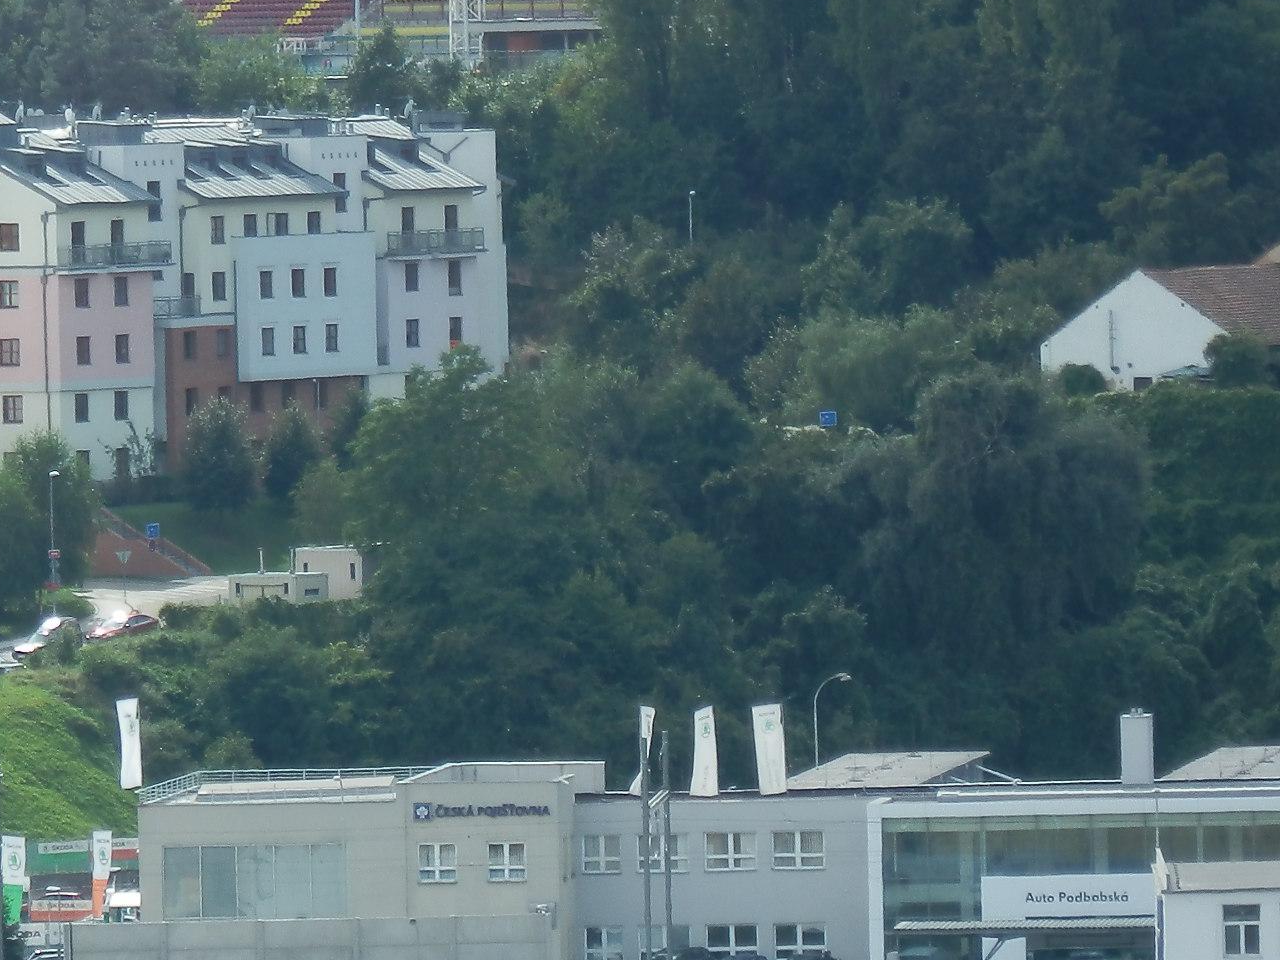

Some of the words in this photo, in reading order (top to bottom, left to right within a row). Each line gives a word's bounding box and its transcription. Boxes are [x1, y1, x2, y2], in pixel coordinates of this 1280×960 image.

[435, 804, 475, 818] ČESKÁ
[1025, 892, 1055, 903] Auto
[1058, 891, 1129, 903] Podbabská
